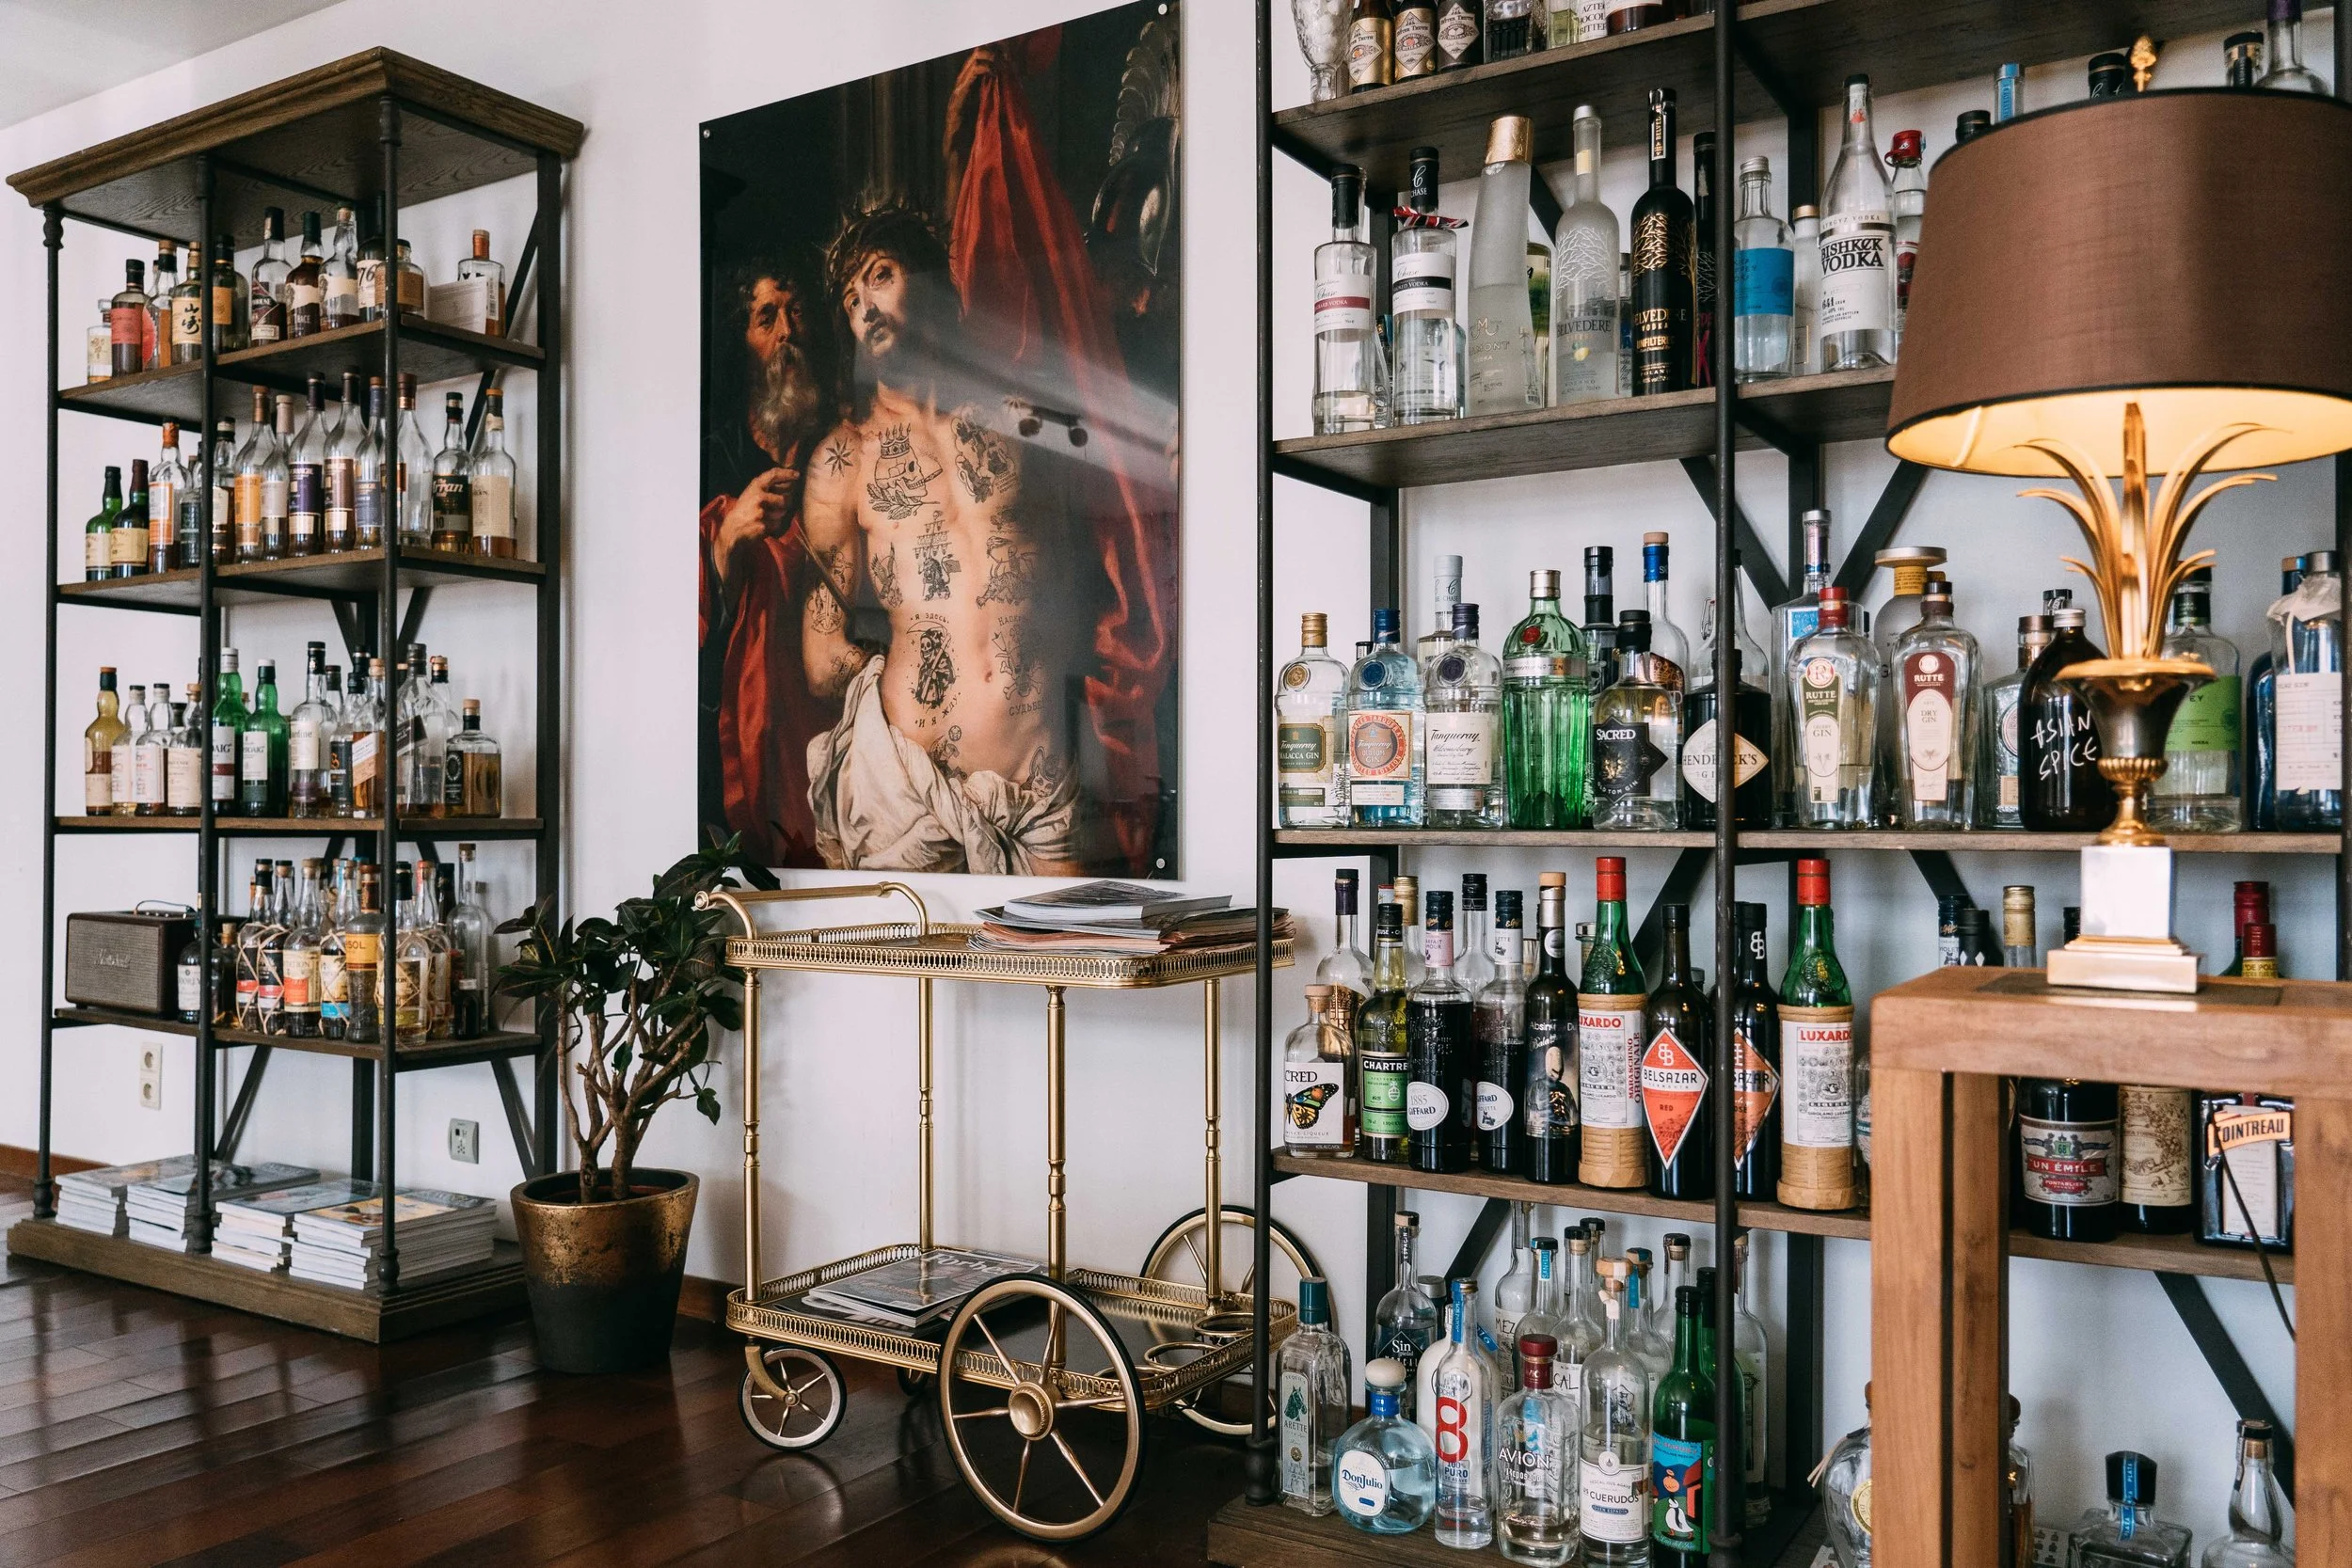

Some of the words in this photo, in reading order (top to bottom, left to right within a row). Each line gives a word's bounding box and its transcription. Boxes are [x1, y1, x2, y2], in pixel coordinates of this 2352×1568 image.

[1821, 251, 1884, 275] VODKA
[1407, 280, 1429, 289] VODKA
[1328, 299, 1348, 308] VODKA
[1558, 320, 1613, 337] BELVEDERE
[1641, 322, 1669, 331] VODKA
[1914, 673, 1946, 683] RUTTE
[1805, 690, 1836, 700] RUTTE
[1596, 728, 1637, 741] SACRED
[2030, 709, 2092, 749] ASIAN
[1279, 739, 1317, 751] Tanqueray
[1306, 752, 1319, 760] GIN
[2039, 736, 2098, 781] SPICE
[1624, 780, 1639, 792] GIN
[1644, 1068, 1697, 1085] BELSAZAR
[1410, 1094, 1428, 1106] 1885
[1660, 1103, 1675, 1112] RED
[2217, 1117, 2284, 1143] OINTREAU
[1392, 1339, 1411, 1353] Sin
[1283, 1419, 1308, 1433] ARETTE
[1436, 1396, 1469, 1464] 8
[1444, 1467, 1469, 1479] PURO
[1590, 1490, 1639, 1504] CUERUDOS
